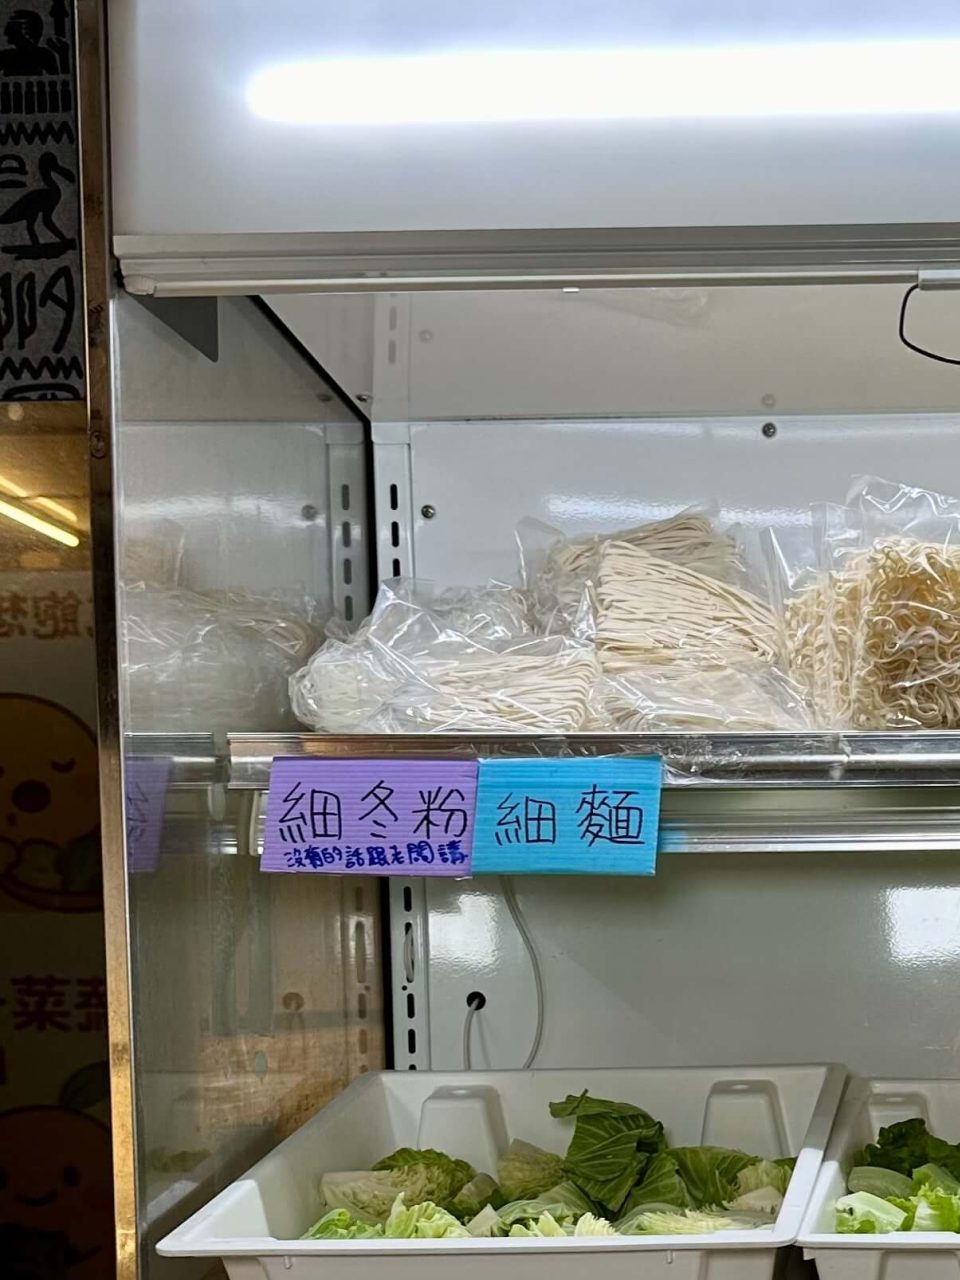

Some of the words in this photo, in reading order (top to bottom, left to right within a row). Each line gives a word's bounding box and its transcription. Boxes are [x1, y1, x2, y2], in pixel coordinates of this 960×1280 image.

[278, 779, 469, 845] 細冬粉
[495, 783, 645, 848] 細麵
